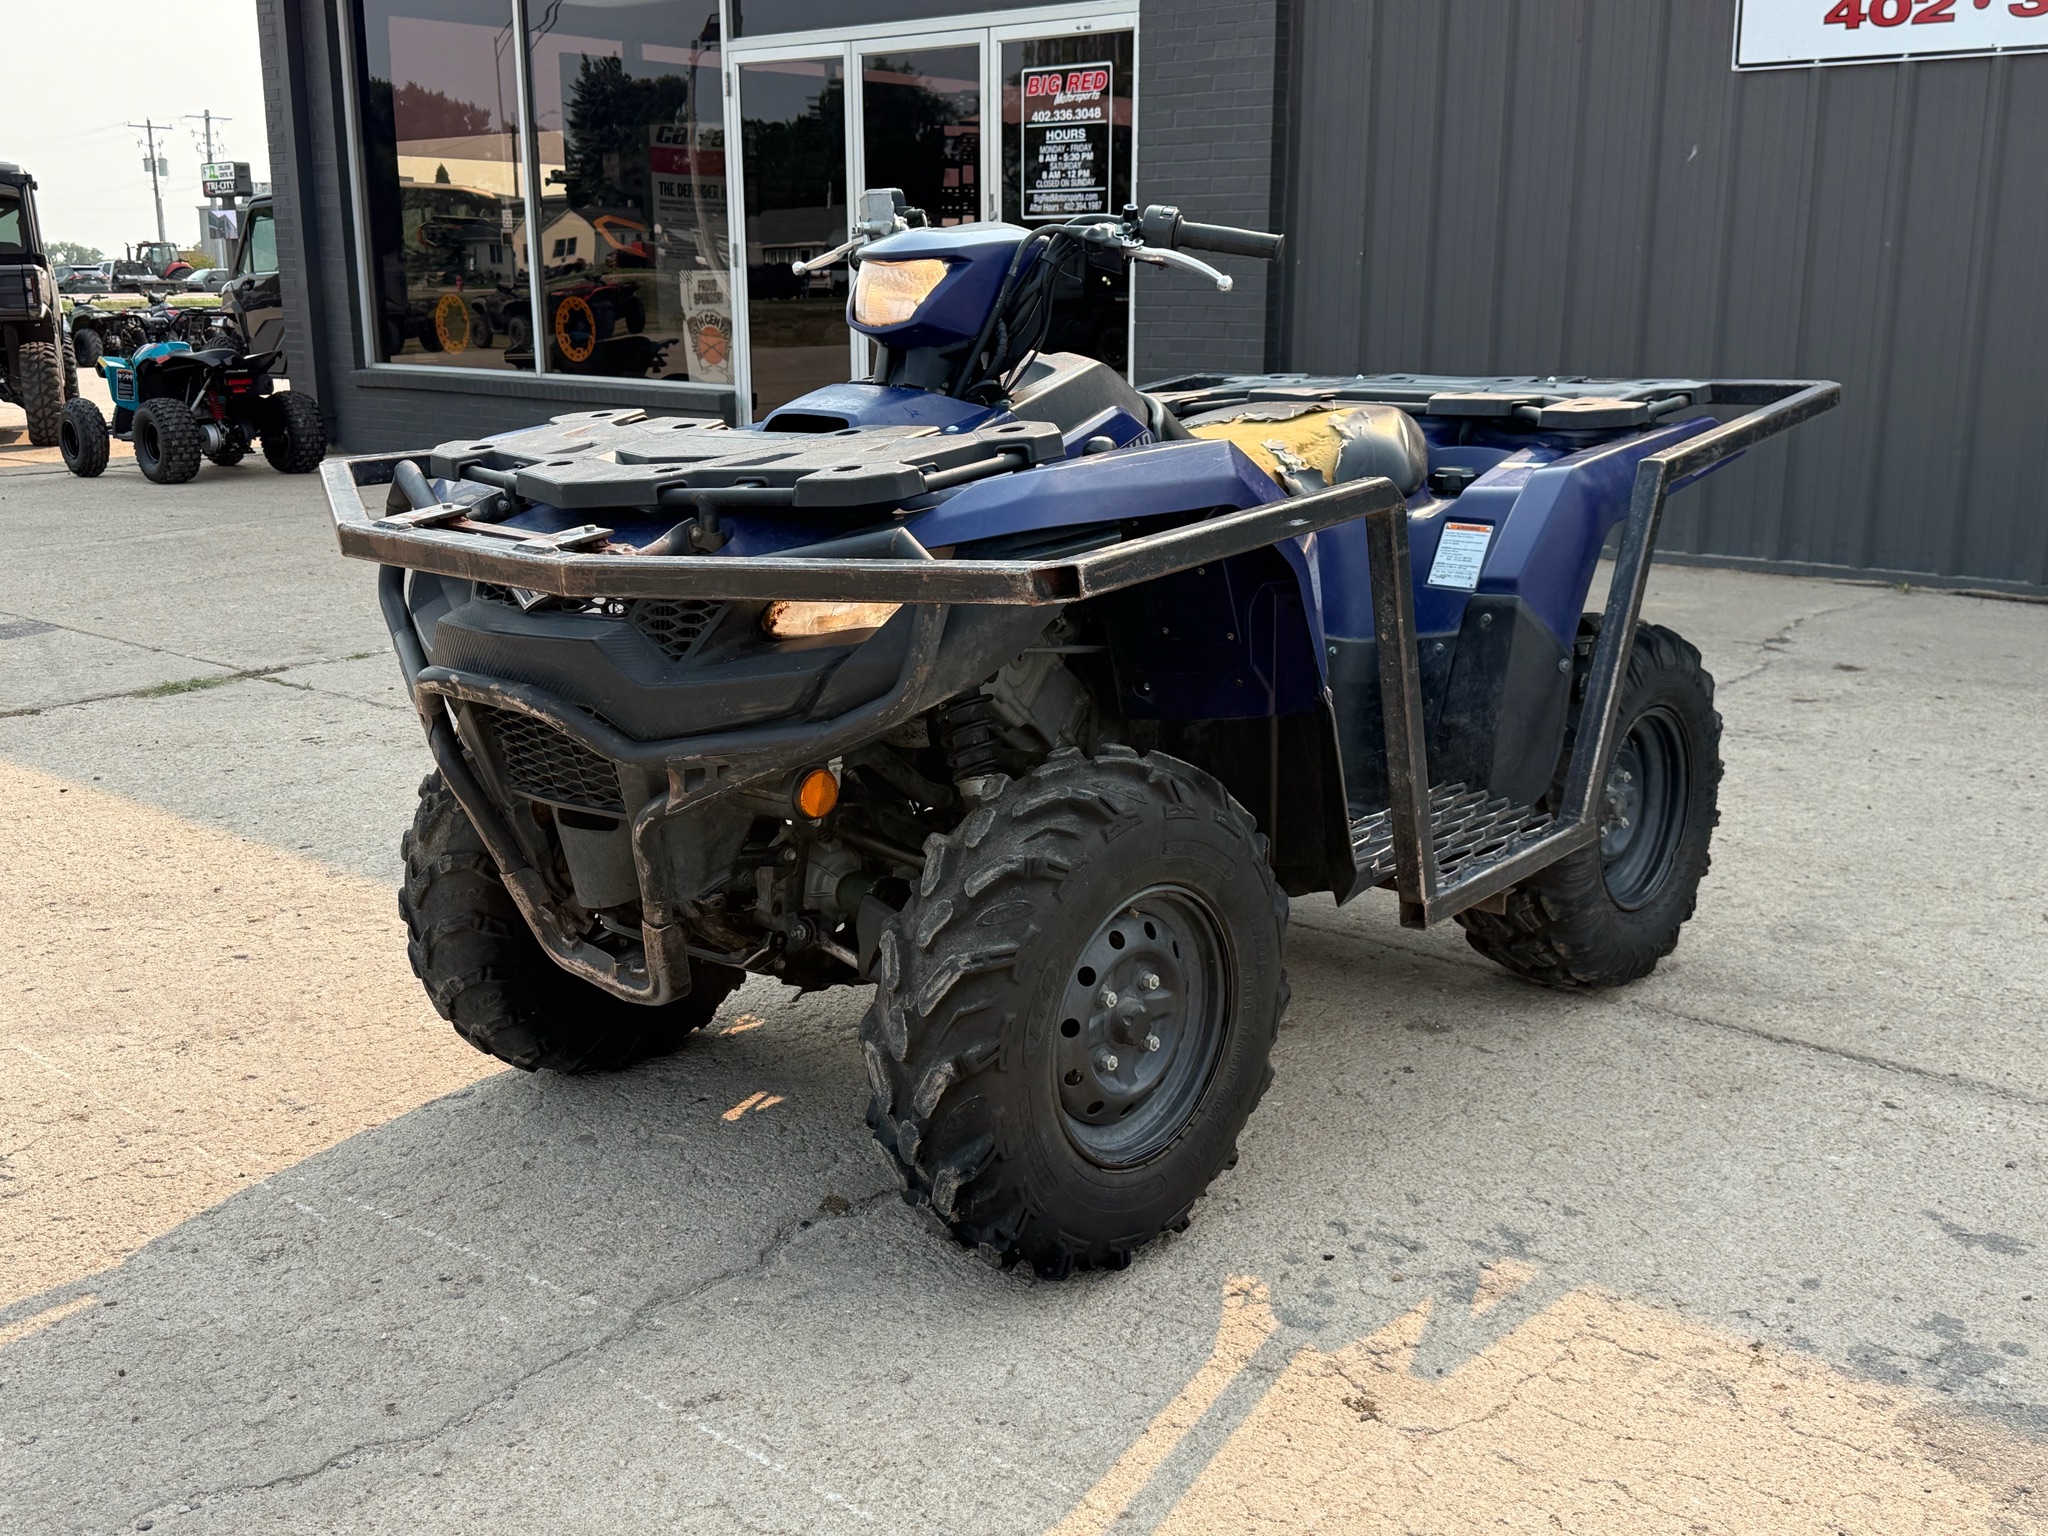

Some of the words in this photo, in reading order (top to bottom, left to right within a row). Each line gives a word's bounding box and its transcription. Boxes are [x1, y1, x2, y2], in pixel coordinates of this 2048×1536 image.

[1823, 0, 1956, 31] 402
[1026, 74, 1063, 97] BIG
[1065, 70, 1108, 94] RED
[1053, 90, 1101, 106] Motorsports
[1031, 107, 1102, 122] 402.336.3048
[1045, 128, 1086, 140] HOURS
[1039, 144, 1066, 155] MONDAY
[1070, 142, 1093, 153] FRIDAY
[1045, 153, 1058, 163] AM
[1063, 152, 1080, 162] 5:30
[1081, 151, 1094, 161] PM
[1049, 160, 1083, 171] SATURDAY
[1048, 170, 1061, 179] AM
[1067, 170, 1076, 179] 12
[1077, 169, 1091, 178] PM
[658, 181, 676, 197] THE
[1035, 179, 1060, 189] CLOSED
[1060, 178, 1070, 187] ON
[1070, 177, 1096, 187] SUNDAY
[1029, 202, 1043, 212] After
[1042, 202, 1060, 212] Hours
